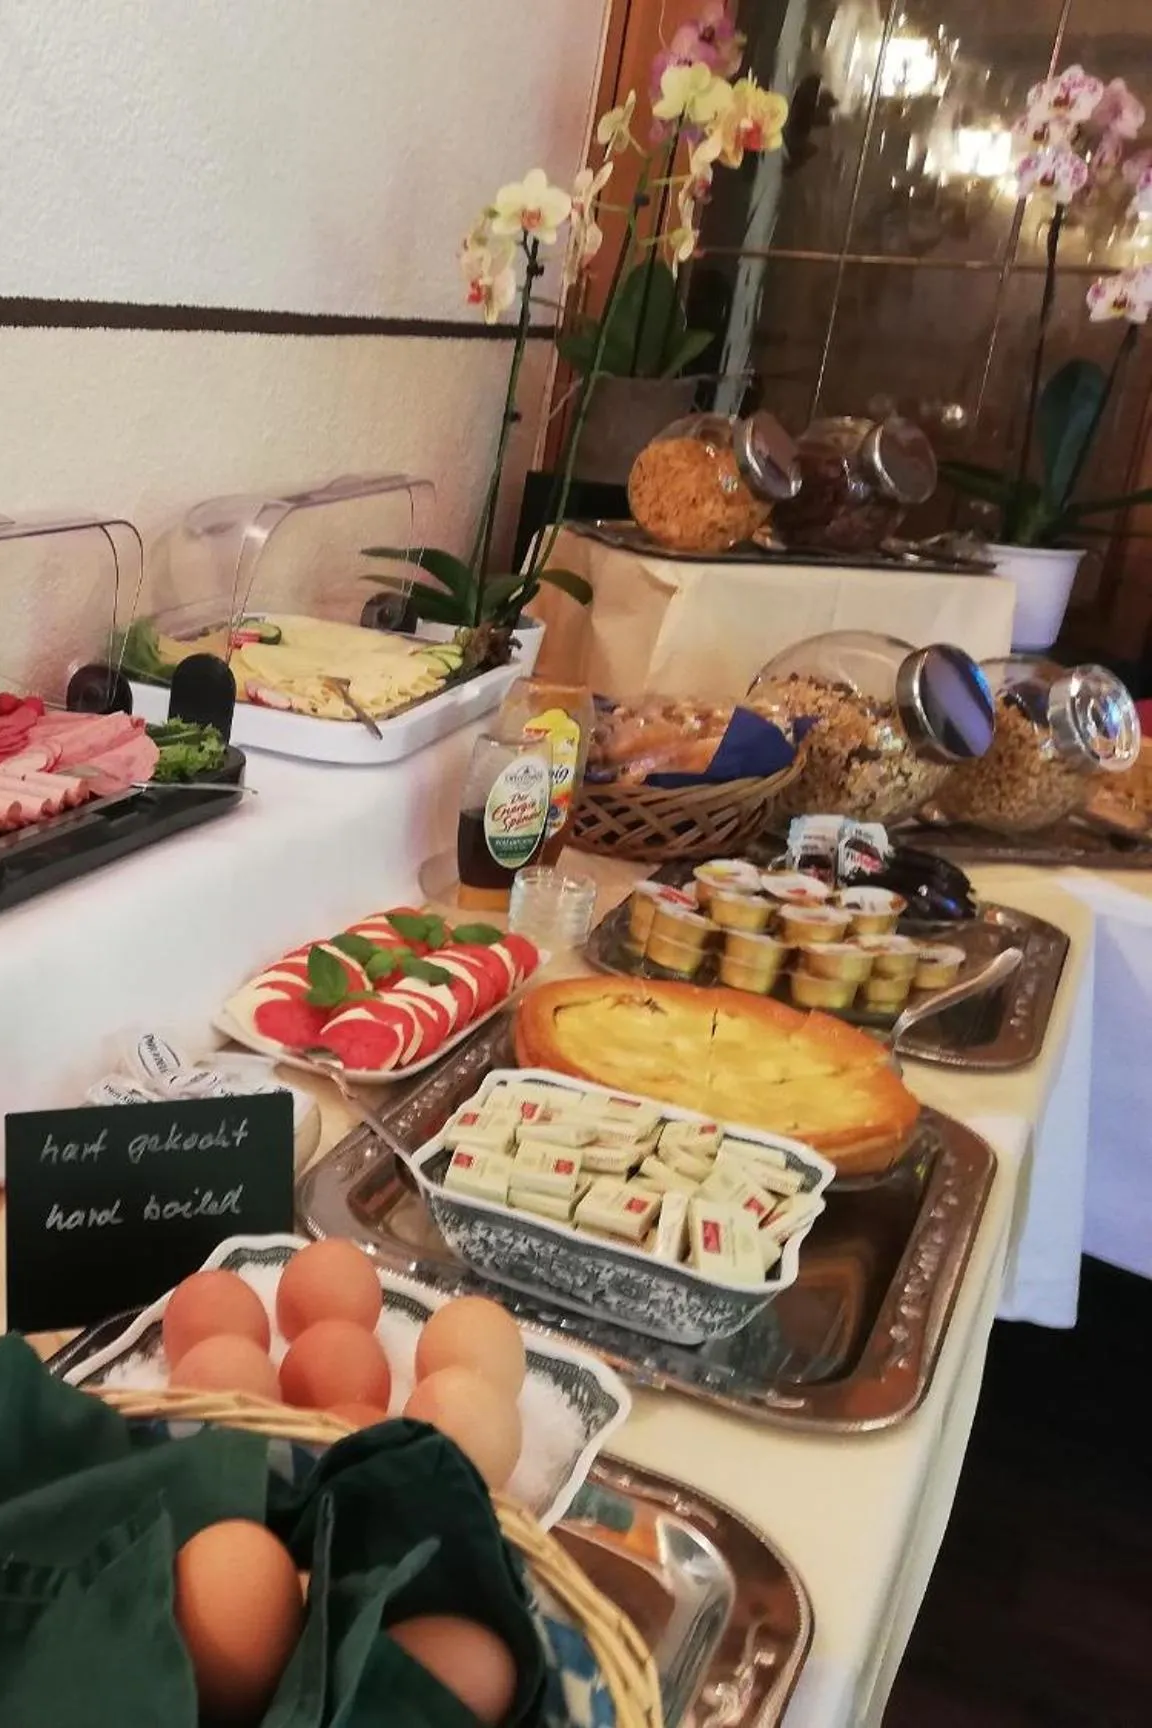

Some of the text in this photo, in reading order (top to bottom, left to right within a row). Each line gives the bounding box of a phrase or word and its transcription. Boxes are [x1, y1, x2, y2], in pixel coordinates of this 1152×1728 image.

[39, 1117, 249, 1165] hart gekocht
[45, 1184, 245, 1232] hard boiled
